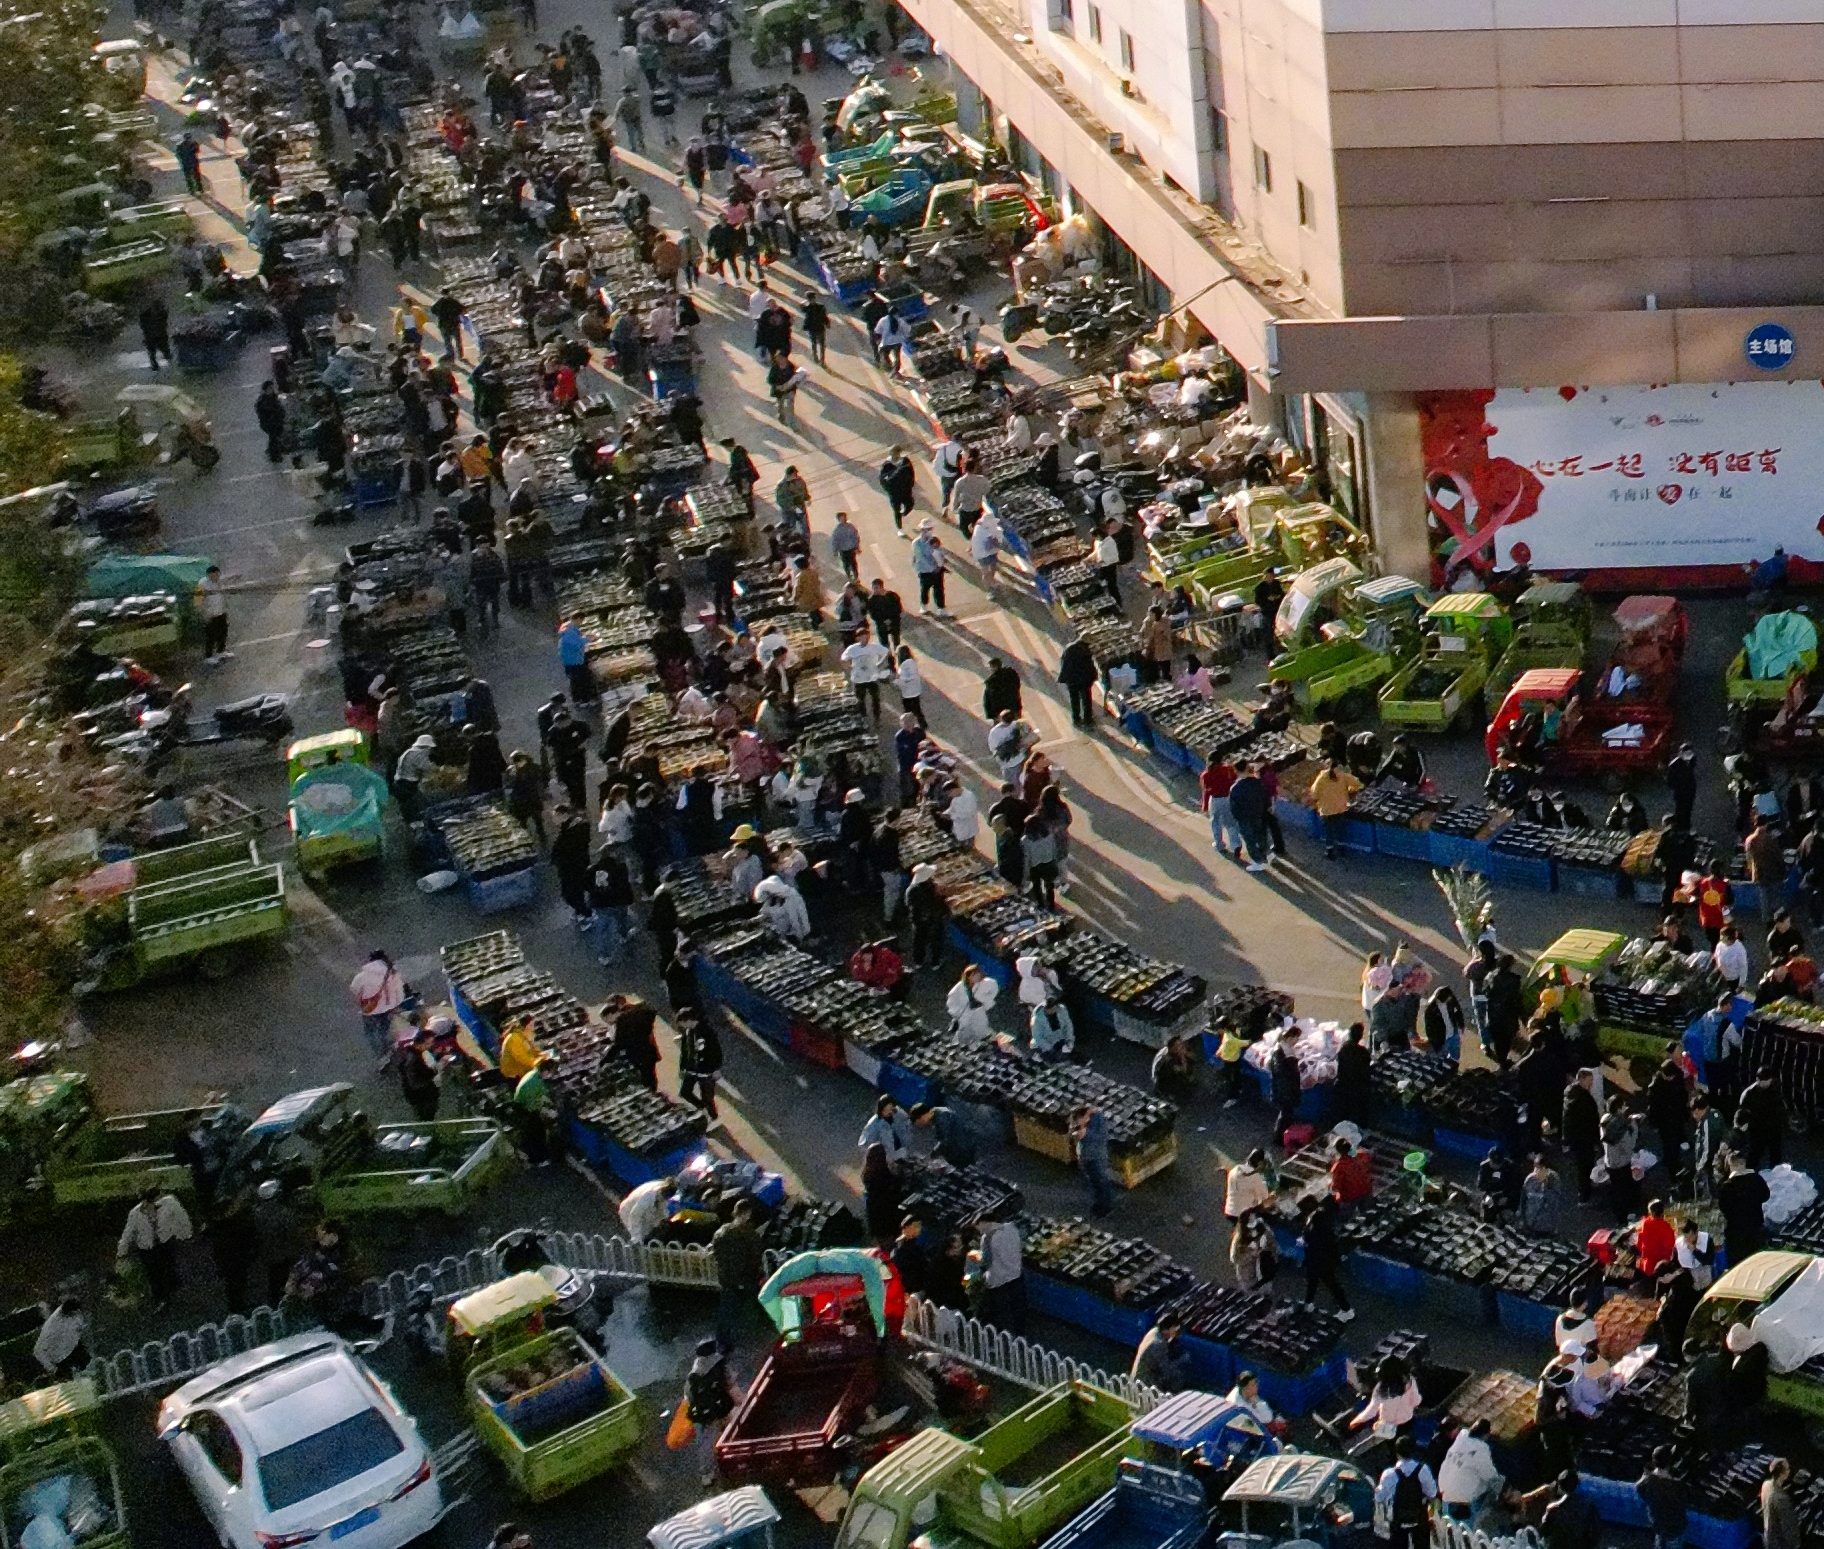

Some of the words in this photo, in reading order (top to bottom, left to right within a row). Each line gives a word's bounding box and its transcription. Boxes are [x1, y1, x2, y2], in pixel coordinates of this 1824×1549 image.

[1749, 338, 1793, 355] 主场馆
[1529, 453, 1646, 479] 心在一起
[1668, 447, 1783, 476] 没有距离
